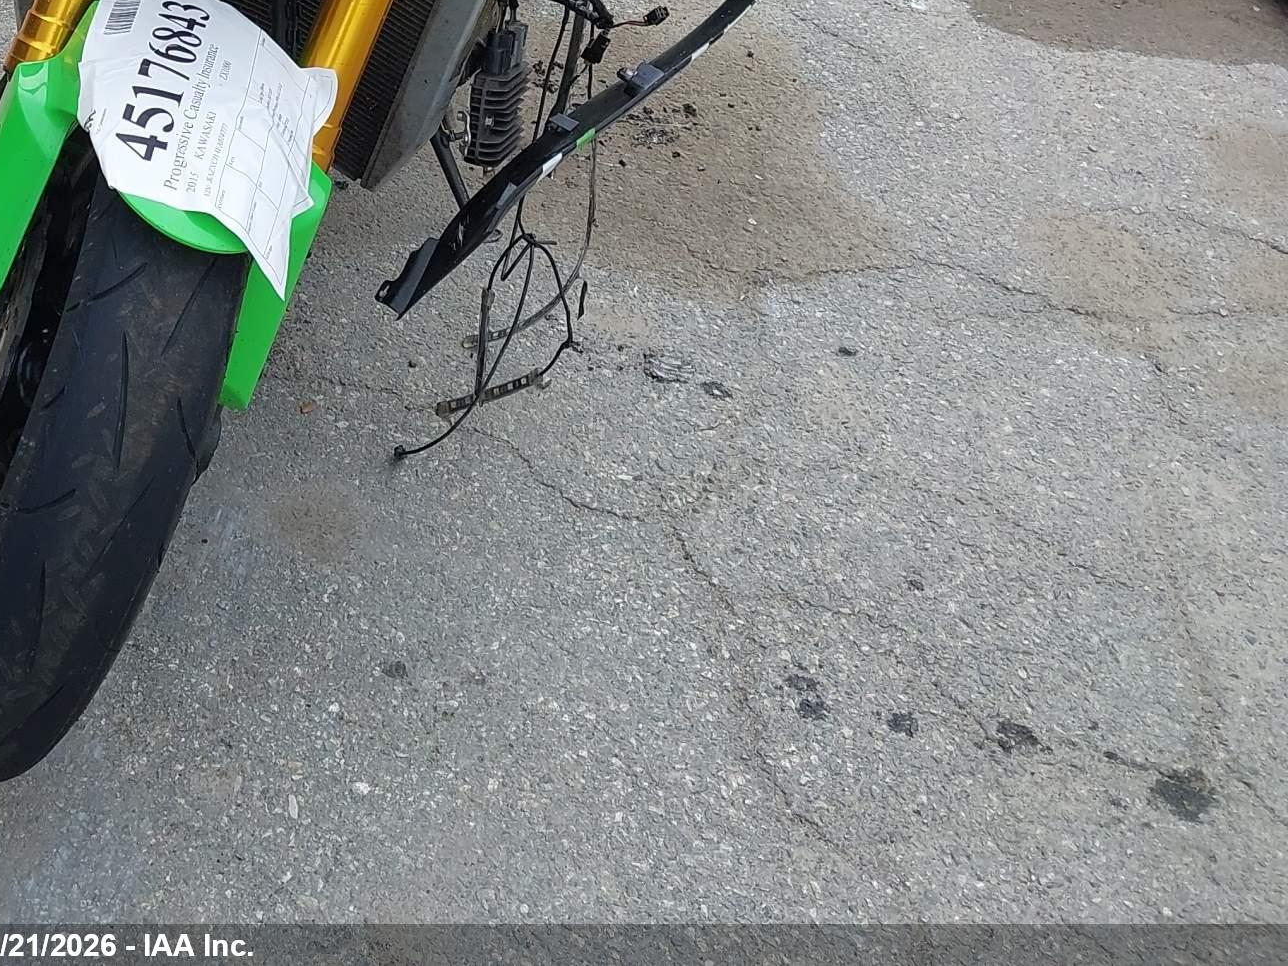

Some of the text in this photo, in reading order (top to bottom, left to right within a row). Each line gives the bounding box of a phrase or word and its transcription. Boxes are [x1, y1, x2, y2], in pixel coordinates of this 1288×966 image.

[115, 0, 210, 161] 45176843
[164, 119, 194, 191] Progressive
[183, 78, 211, 121] Casualty
[193, 111, 217, 161] KAWASAKI
